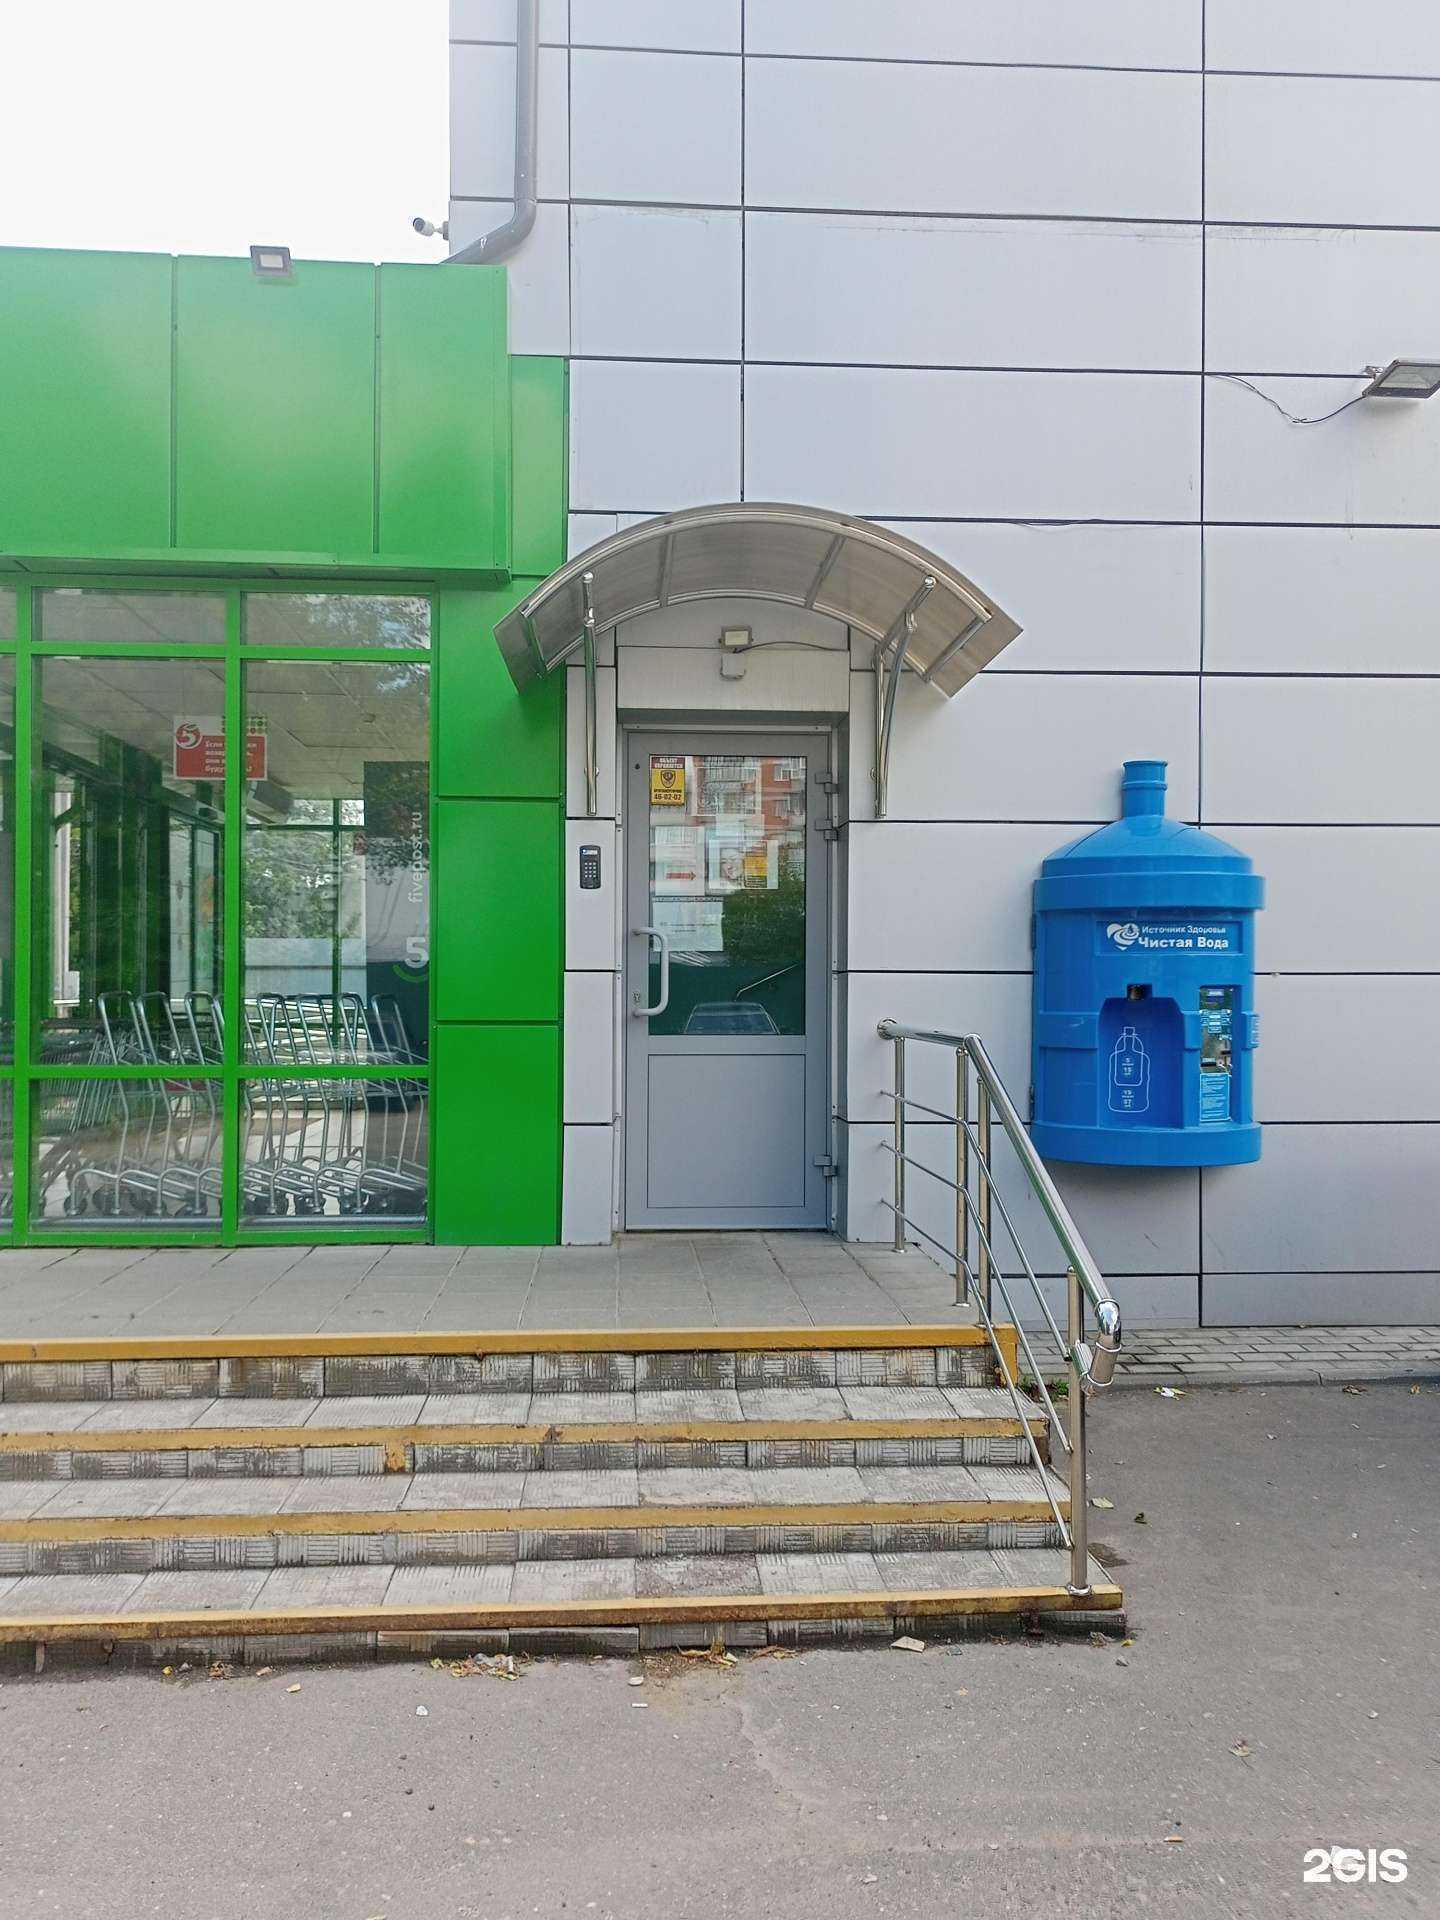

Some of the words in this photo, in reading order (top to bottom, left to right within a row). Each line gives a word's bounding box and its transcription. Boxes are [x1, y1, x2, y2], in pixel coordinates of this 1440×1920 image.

[407, 811, 423, 903] fivepost.ru
[1141, 925, 1186, 934] Источник
[1187, 925, 1226, 935] Здоровья
[404, 936, 430, 969] 5
[1138, 937, 1193, 948] Чистая
[1197, 937, 1229, 950] Вода
